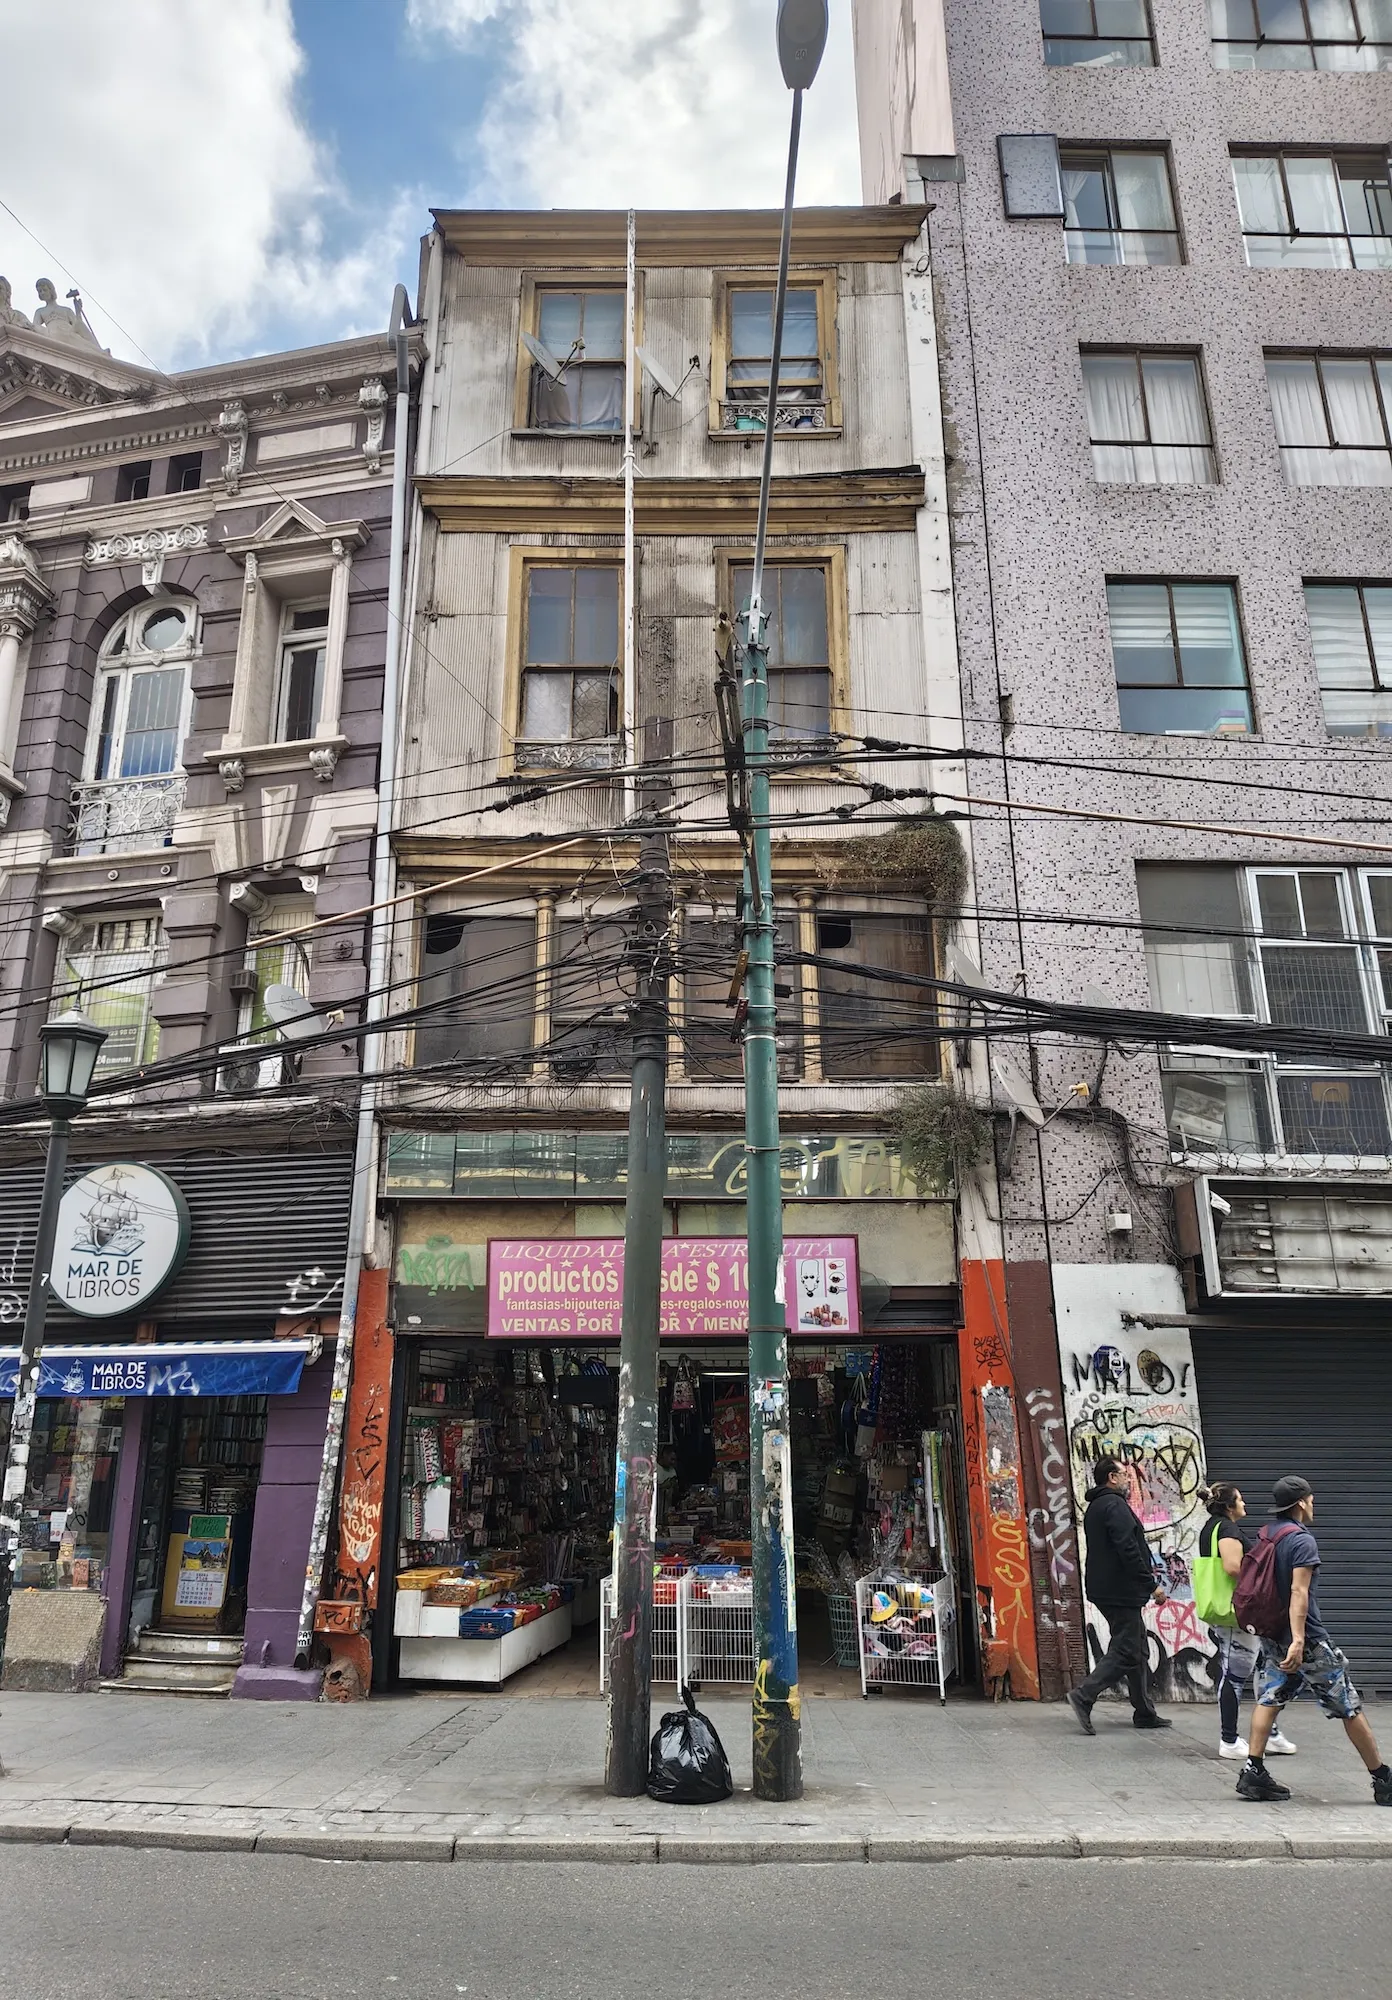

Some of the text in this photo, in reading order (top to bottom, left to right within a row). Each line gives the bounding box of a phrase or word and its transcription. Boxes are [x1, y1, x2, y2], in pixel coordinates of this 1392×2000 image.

[688, 1243, 836, 1258] ESTRLITA
[68, 1259, 143, 1278] MAR DE
[498, 1263, 619, 1300] productos
[706, 1260, 720, 1295] $
[66, 1278, 141, 1299] LIBROS
[501, 1317, 571, 1332] VENTAS
[577, 1317, 613, 1332] POR
[686, 1317, 698, 1331] Y
[92, 1361, 147, 1375] MAR DE
[91, 1375, 146, 1390] LIBROS
